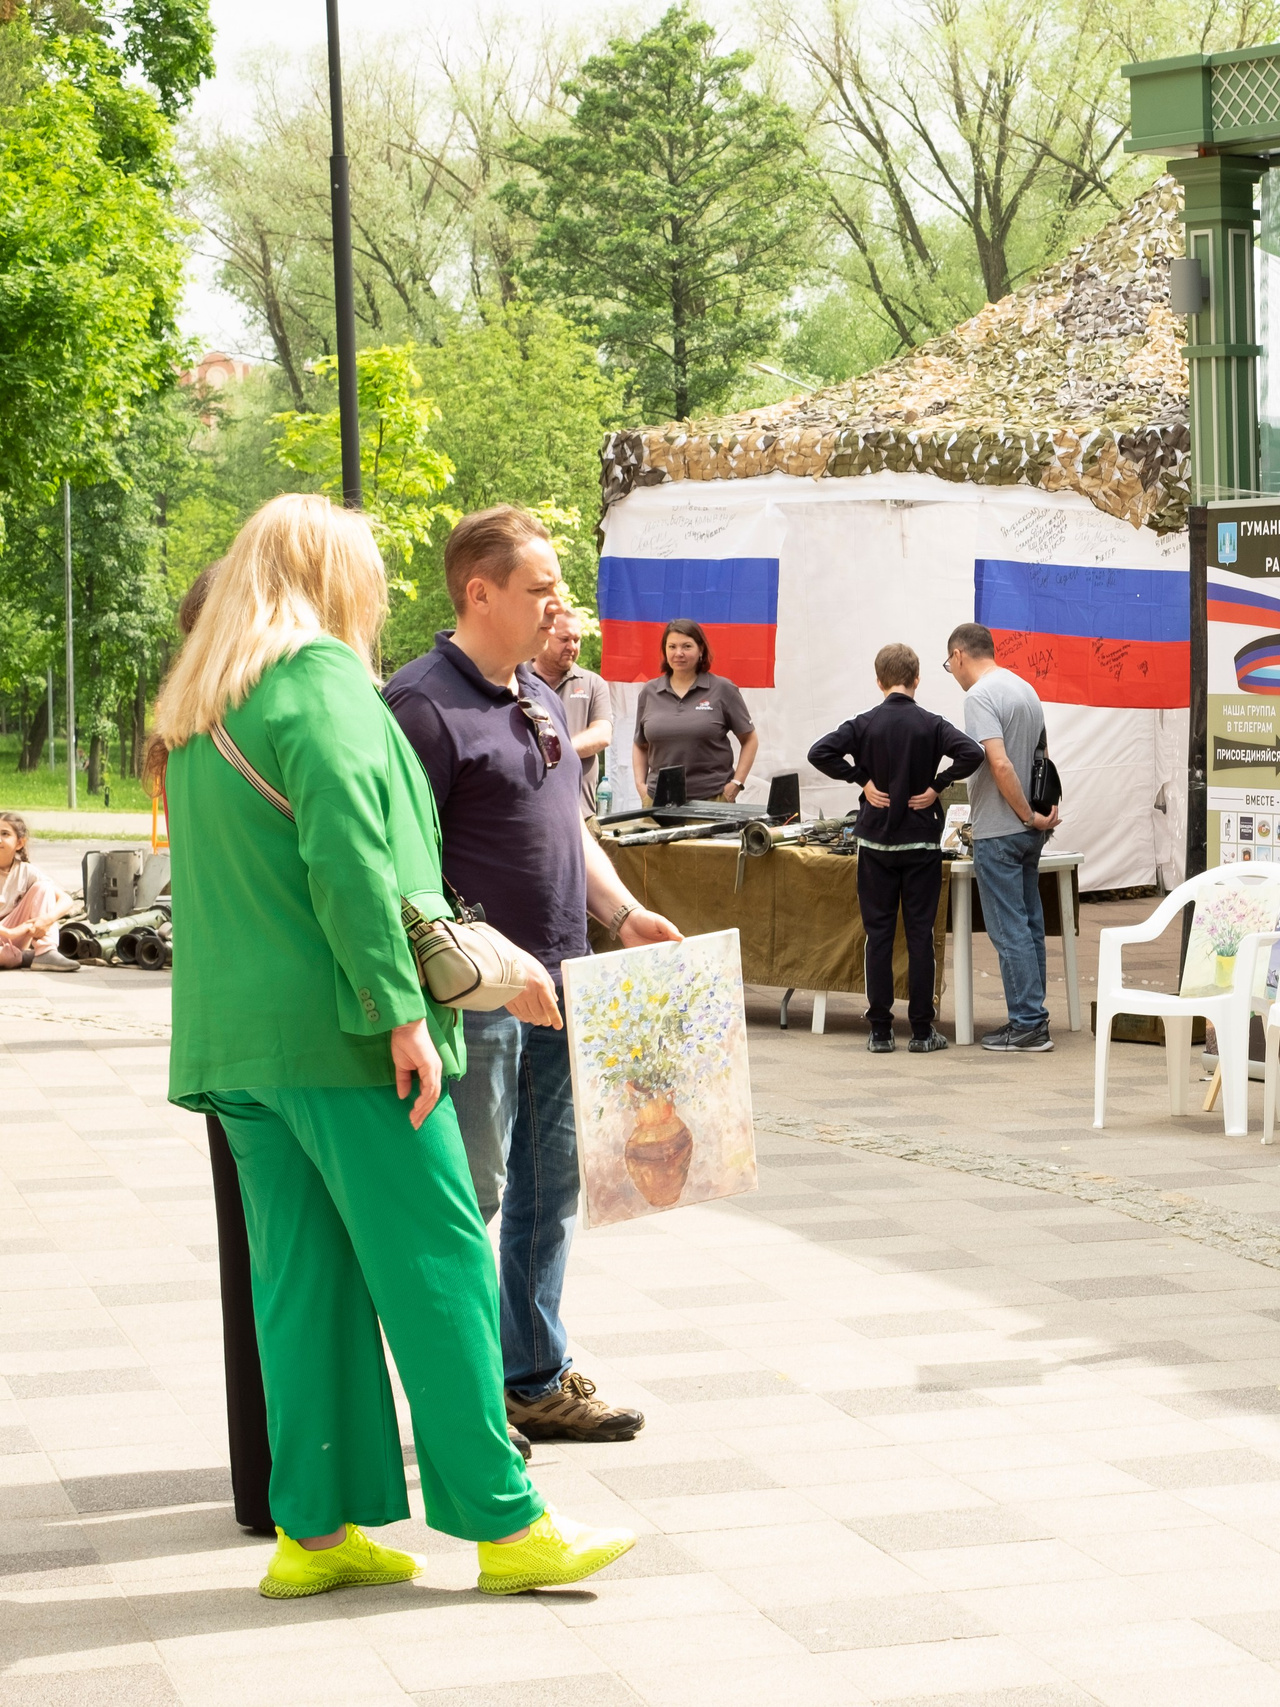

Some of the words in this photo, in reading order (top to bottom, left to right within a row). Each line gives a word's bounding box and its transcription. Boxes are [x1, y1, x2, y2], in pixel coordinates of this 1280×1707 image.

[1222, 704, 1245, 716] НАША
[1247, 705, 1276, 717] ГРУППА
[1227, 721, 1232, 732] В
[1234, 721, 1273, 733] ТЕЛЕГРАМ
[1245, 794, 1275, 807] ВМЕСТЕ
